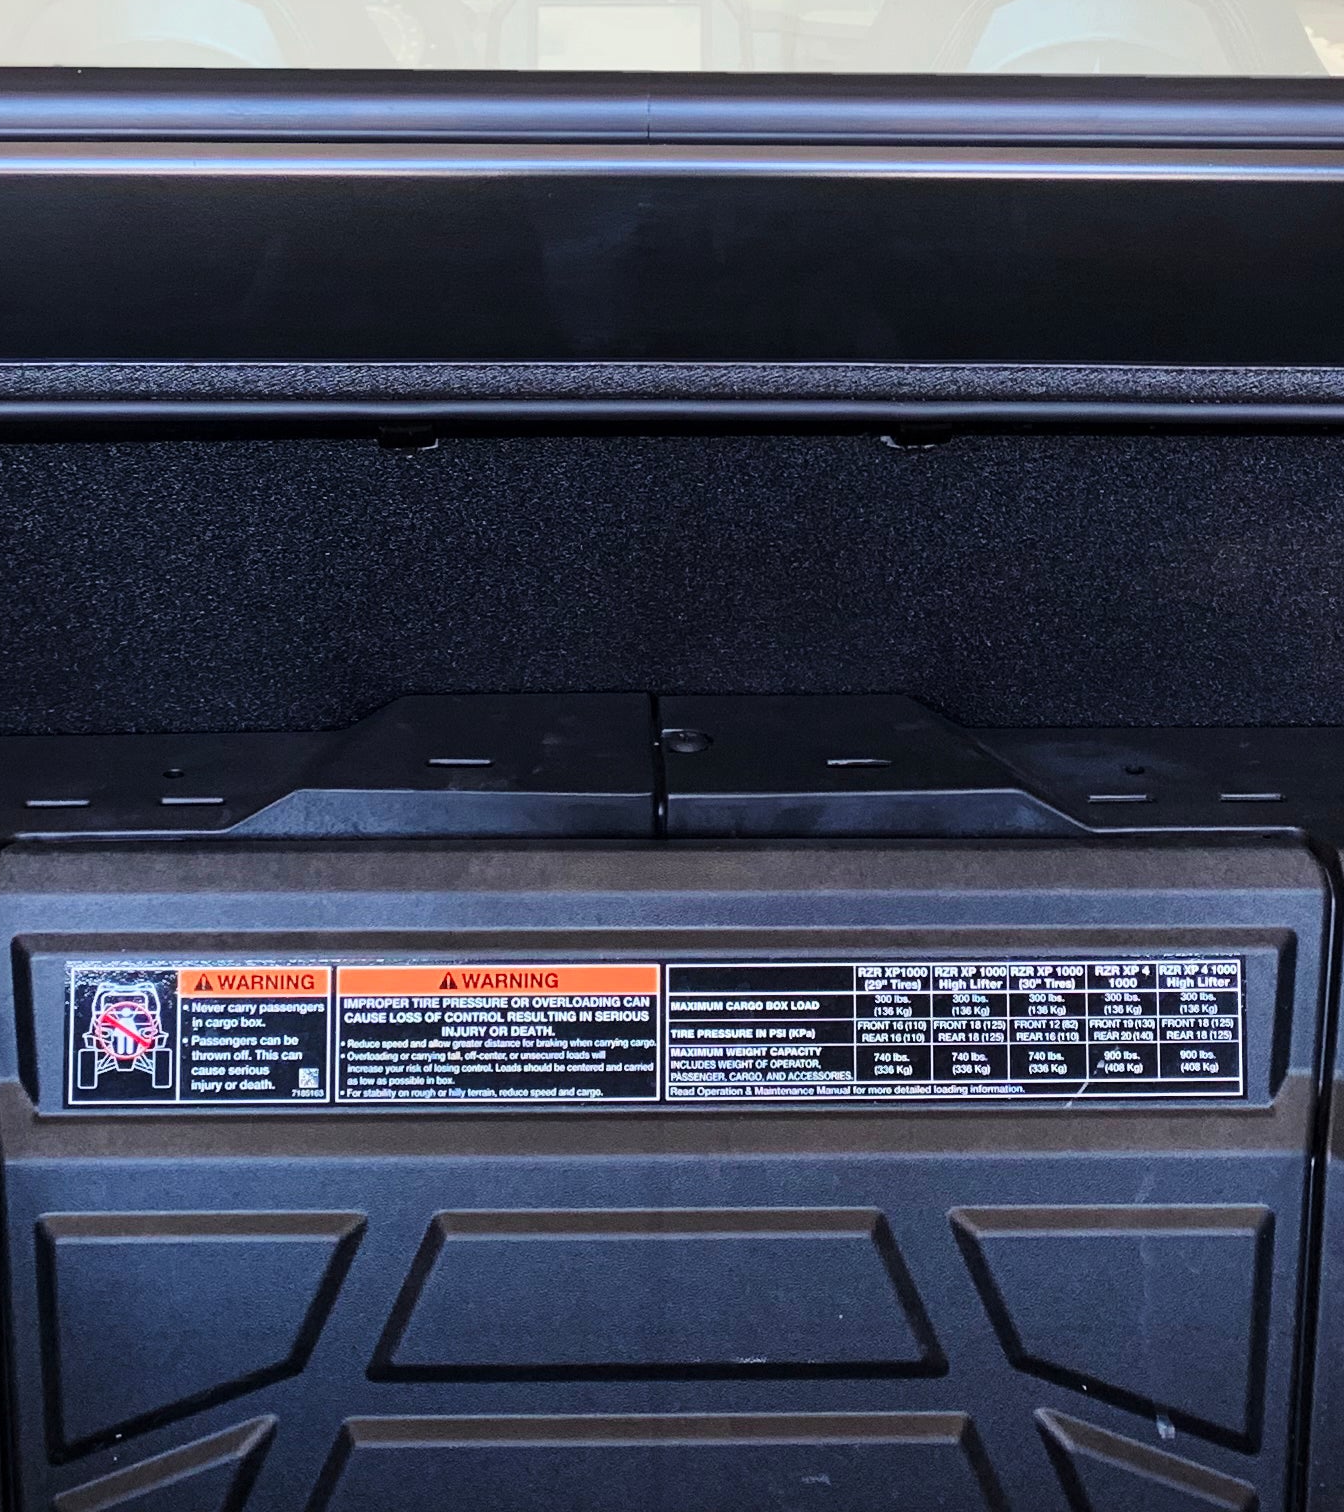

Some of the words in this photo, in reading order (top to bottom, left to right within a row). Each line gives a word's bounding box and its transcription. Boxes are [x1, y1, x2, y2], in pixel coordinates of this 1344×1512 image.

[858, 967, 882, 978] RZR
[885, 967, 928, 978] XP1000
[935, 967, 958, 978] RZR
[961, 966, 977, 978] XP
[980, 967, 1006, 977] 1000
[1010, 966, 1034, 977] RZR
[1037, 966, 1053, 977] XP
[1056, 966, 1084, 977] 1000
[1095, 965, 1120, 976] RZR
[1122, 965, 1140, 976] XP
[1142, 965, 1150, 976] 4
[1159, 965, 1182, 976] RZR
[1183, 964, 1199, 976] XP
[1201, 964, 1209, 975] 4
[1211, 964, 1237, 975] 1000
[217, 974, 314, 990] WARNING
[462, 972, 559, 989] WARNING
[890, 979, 921, 991] Tires)
[939, 979, 967, 991] High
[970, 979, 1004, 991] Lifter
[1042, 978, 1076, 991] Tires)
[1109, 978, 1138, 988] 1000
[1166, 977, 1194, 989] High
[1197, 977, 1231, 989] Lifter
[344, 998, 409, 1009] IMPROPER
[411, 998, 440, 1008] TIRE
[442, 997, 509, 1009] PRESSURE
[511, 997, 530, 1008] OR
[532, 997, 621, 1008] OVERLOADING
[623, 996, 650, 1008] CAN
[875, 994, 892, 1004] 300
[894, 995, 911, 1004] lbs.
[192, 1001, 226, 1013] Never
[227, 1004, 257, 1015] carry
[259, 1003, 325, 1015] passengers
[671, 1001, 724, 1011] MAXIMUM
[726, 1001, 764, 1011] CARGO
[766, 1001, 789, 1010] BOX
[791, 1001, 820, 1010] LOAD
[874, 1007, 894, 1017] (136
[896, 1006, 913, 1017] Kg)
[344, 1012, 387, 1023] CAUSE
[389, 1012, 423, 1023] LOSS
[424, 1012, 442, 1023] OF
[444, 1011, 505, 1023] CONTROL
[507, 1011, 577, 1022] RESULTING
[579, 1011, 593, 1022] IN
[595, 1011, 650, 1022] SERIOUS
[192, 1017, 203, 1029] in
[205, 1019, 239, 1030] cargo
[240, 1017, 266, 1027] box.
[858, 1021, 891, 1031] FRONT
[892, 1021, 904, 1030] 16
[905, 1021, 927, 1031] (110)
[933, 1020, 968, 1030] FRONT
[970, 1020, 981, 1030] 18
[983, 1020, 1006, 1031] (125)
[1014, 1020, 1047, 1029] FRONT
[1089, 1019, 1121, 1029] FRONT
[1161, 1018, 1196, 1028] FRONT
[1198, 1019, 1210, 1028] 18
[1211, 1018, 1234, 1029] (125)
[442, 1026, 487, 1037] INJURY
[489, 1026, 508, 1037] OR
[511, 1026, 556, 1037] DEATH.
[670, 1029, 695, 1039] TIRE
[697, 1029, 754, 1039] PRESSURE
[756, 1029, 767, 1038] IN
[769, 1029, 787, 1038] PSI
[789, 1028, 816, 1039] (KPa)
[1016, 1032, 1043, 1041] REAR
[1045, 1032, 1056, 1041] 16
[1057, 1032, 1079, 1042] (110)
[1094, 1031, 1120, 1041] REAR
[1166, 1030, 1194, 1040] REAR
[1196, 1030, 1208, 1039] 18
[1209, 1030, 1232, 1040] (125)
[191, 1035, 258, 1048] Passengers
[260, 1037, 281, 1046] can
[284, 1035, 299, 1045] be
[862, 1033, 889, 1042] REAR
[890, 1033, 902, 1042] 16
[903, 1033, 925, 1043] (110)
[938, 1032, 966, 1042] REAR
[968, 1032, 980, 1042] 18
[981, 1032, 1004, 1043] (125)
[347, 1039, 381, 1048] Reduce
[382, 1039, 409, 1049] speed
[410, 1039, 427, 1048] and
[428, 1039, 451, 1048] allow
[452, 1039, 483, 1049] greater
[484, 1039, 521, 1048] distance
[522, 1039, 535, 1048] for
[536, 1038, 568, 1049] braking
[570, 1038, 593, 1048] when
[594, 1038, 629, 1049] carrying
[630, 1039, 657, 1049] cargo.
[192, 1050, 231, 1061] thrown
[233, 1050, 252, 1061] off.
[255, 1049, 279, 1060] This
[281, 1051, 303, 1060] can
[670, 1048, 724, 1057] MAXIMUM
[726, 1047, 768, 1057] WEIGHT
[770, 1047, 822, 1057] CAPACITY
[671, 1060, 717, 1070] INCLUDES
[718, 1059, 754, 1070] WEIGHT
[755, 1059, 769, 1069] OF
[191, 1067, 226, 1076] cause
[228, 1065, 270, 1076] serious
[766, 1072, 787, 1081] AND
[788, 1071, 854, 1081] ACCESSORIES.
[191, 1080, 223, 1092] injury
[225, 1082, 238, 1090] or
[239, 1079, 276, 1090] death.
[670, 1085, 695, 1096] Read
[697, 1085, 744, 1096] Operation
[745, 1087, 753, 1096] &
[754, 1086, 815, 1096] Maintenance
[816, 1086, 851, 1095] Manual
[853, 1086, 867, 1095] for
[894, 1085, 932, 1094] detailed
[933, 1085, 969, 1095] loading
[970, 1084, 1025, 1094] information.
[347, 1088, 362, 1098] For
[363, 1089, 397, 1098] stability
[398, 1090, 410, 1098] on
[411, 1088, 436, 1098] rough
[467, 1088, 498, 1097] terrain,
[499, 1088, 529, 1097] reduce
[530, 1088, 557, 1098] speed
[558, 1087, 575, 1097] and
[576, 1089, 603, 1098] cargo.
